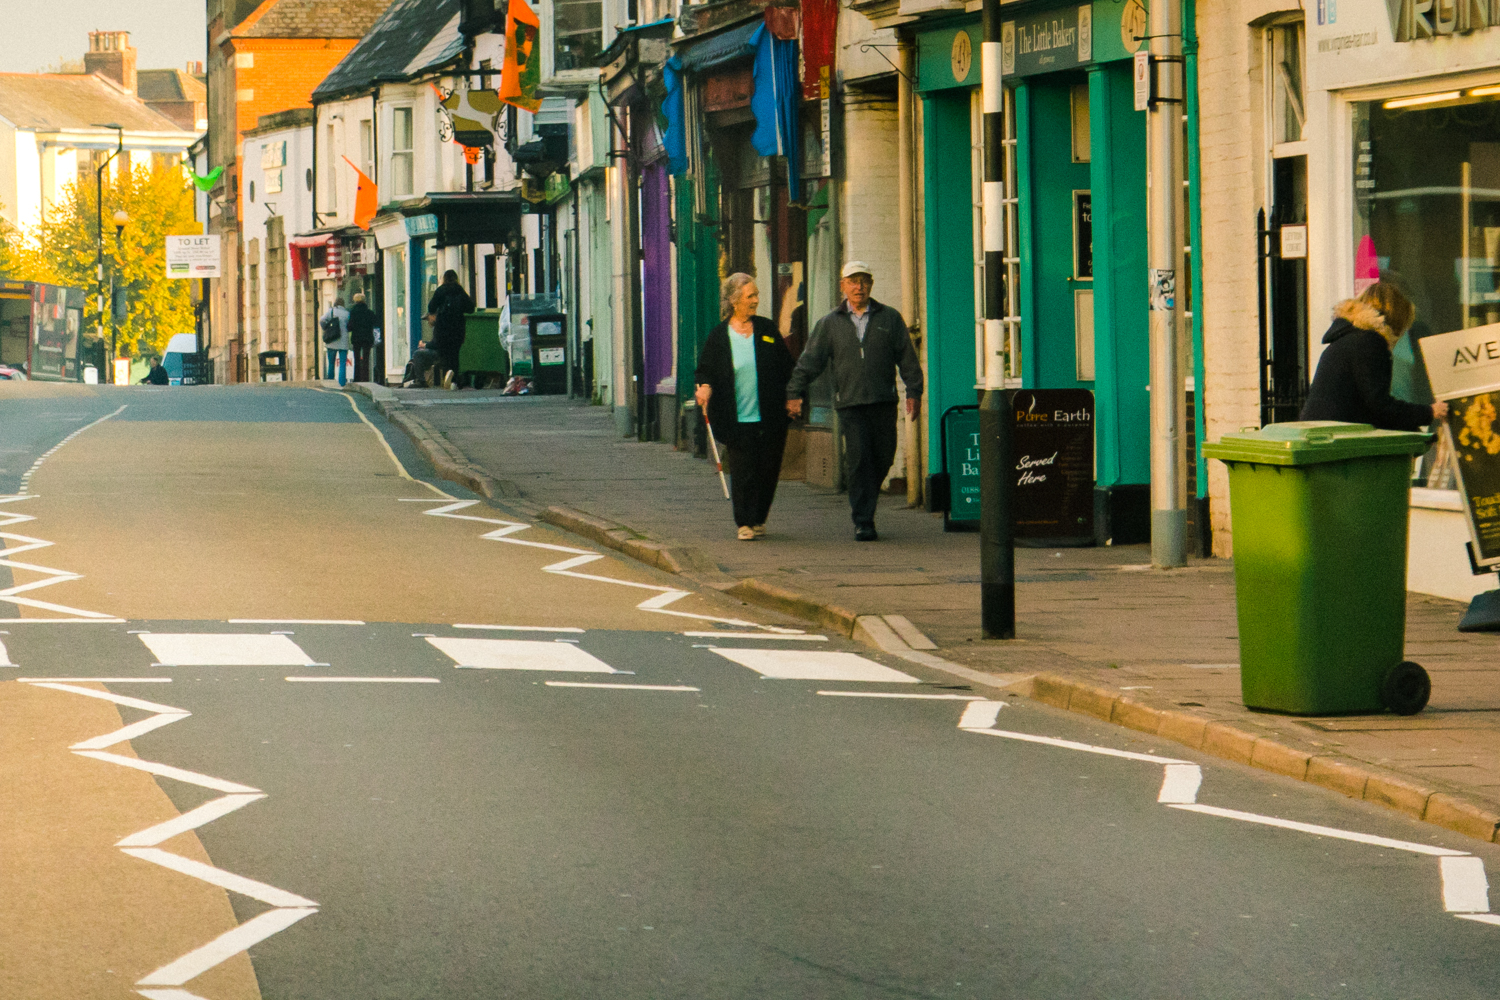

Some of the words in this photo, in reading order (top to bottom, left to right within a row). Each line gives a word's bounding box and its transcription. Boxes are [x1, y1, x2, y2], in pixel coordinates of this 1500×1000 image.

[1018, 26, 1031, 54] The
[1033, 23, 1051, 52] Little
[1053, 19, 1076, 51] Bakery
[178, 238, 191, 246] TO
[194, 238, 209, 246] LET
[1453, 341, 1500, 367] AVE
[1016, 410, 1048, 422] Pure
[1054, 408, 1091, 422] Earth
[1016, 451, 1058, 470] Served
[1017, 470, 1047, 486] Here
